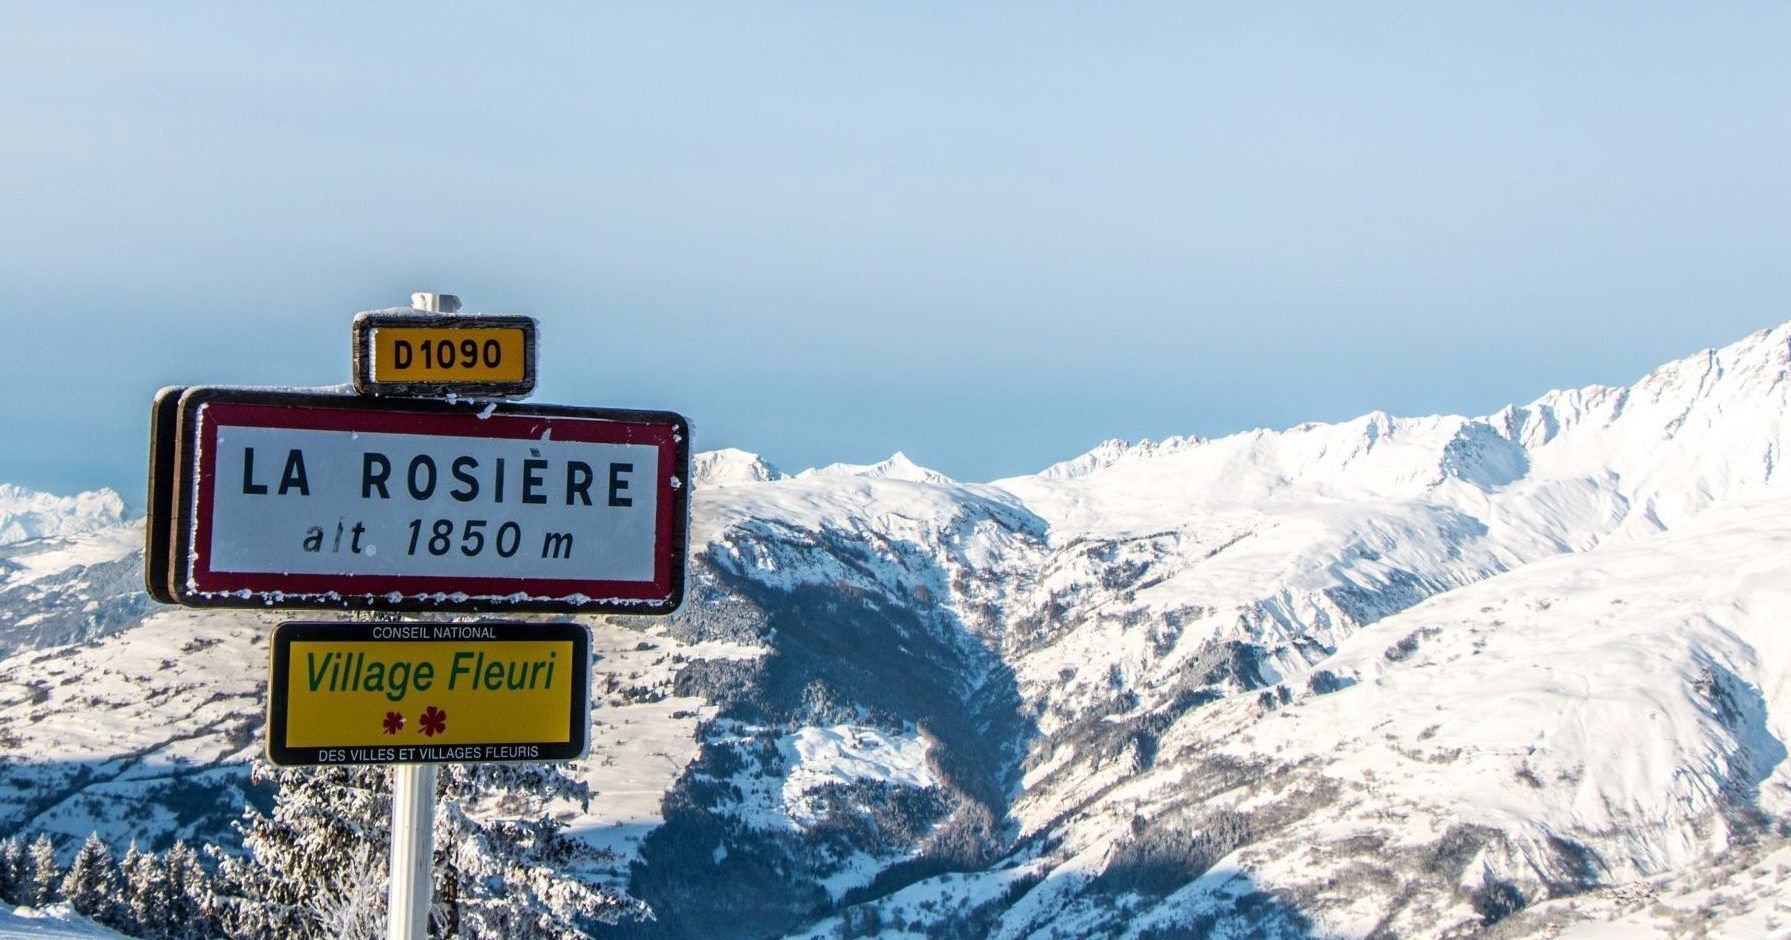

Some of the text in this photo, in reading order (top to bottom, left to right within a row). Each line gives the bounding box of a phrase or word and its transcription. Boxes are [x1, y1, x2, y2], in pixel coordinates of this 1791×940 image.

[394, 339, 502, 369] D1090
[241, 447, 635, 508] LA ROSIÈRE
[406, 518, 522, 559] 1850
[541, 530, 574, 560] m
[372, 626, 497, 640] CONSEIL NATIONAL
[306, 651, 558, 702] Village Fleuri
[318, 745, 539, 762] DES VILLES ET VILLAGES FLEURIS
